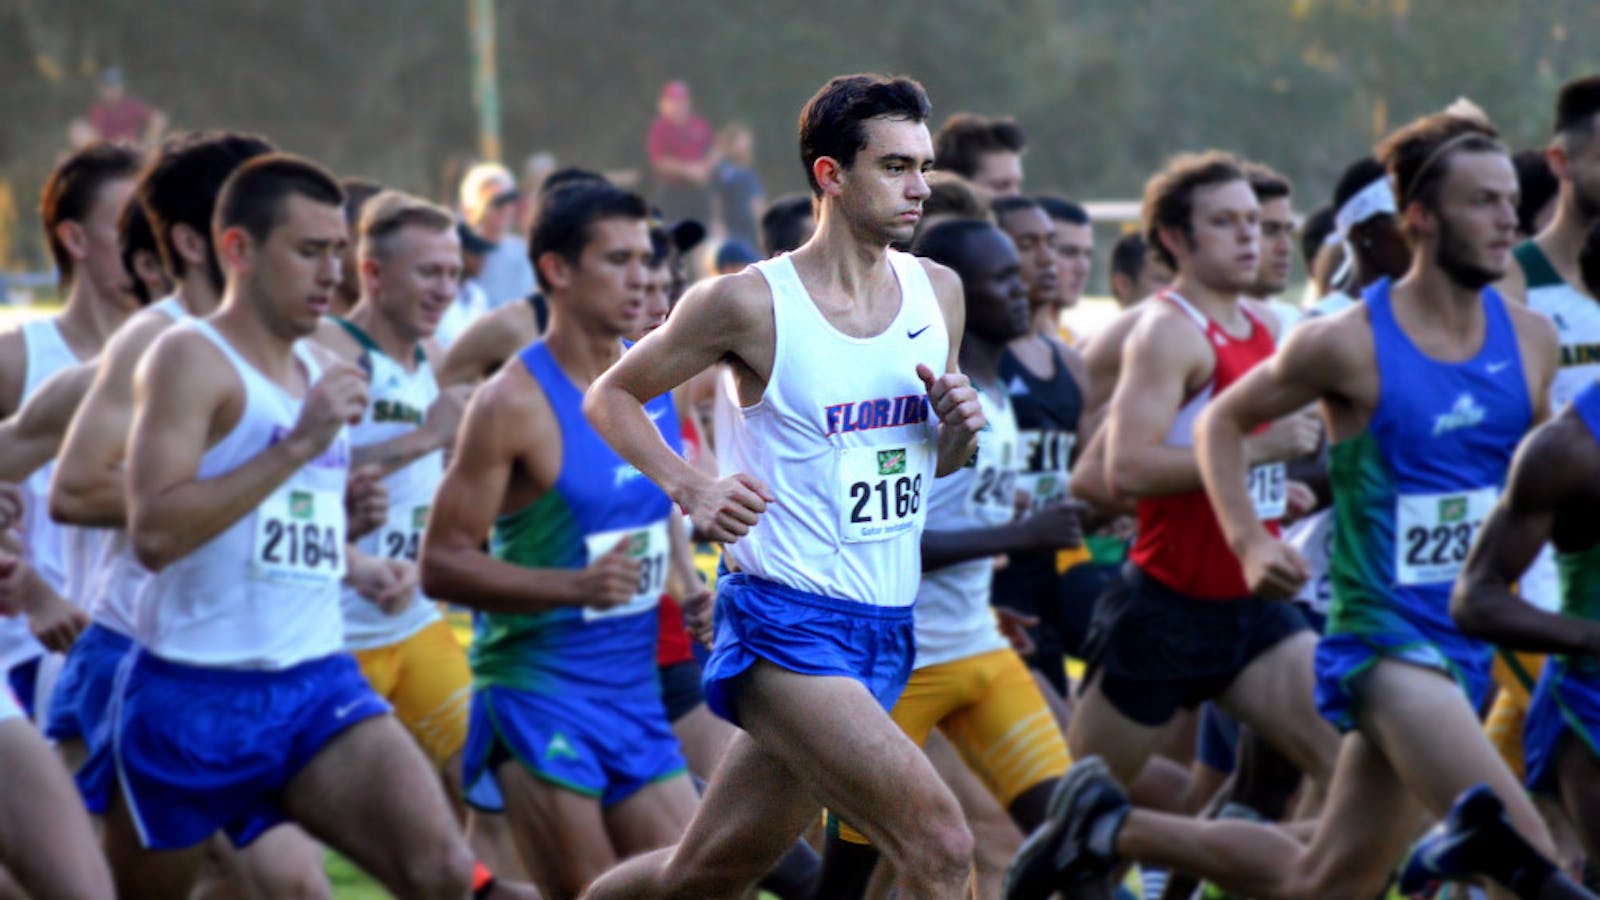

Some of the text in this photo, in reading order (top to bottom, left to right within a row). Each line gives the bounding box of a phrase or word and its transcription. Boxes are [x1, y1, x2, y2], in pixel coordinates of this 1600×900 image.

[850, 473, 922, 523] 2168
[261, 518, 339, 571] 2164
[1405, 519, 1483, 567] 223
